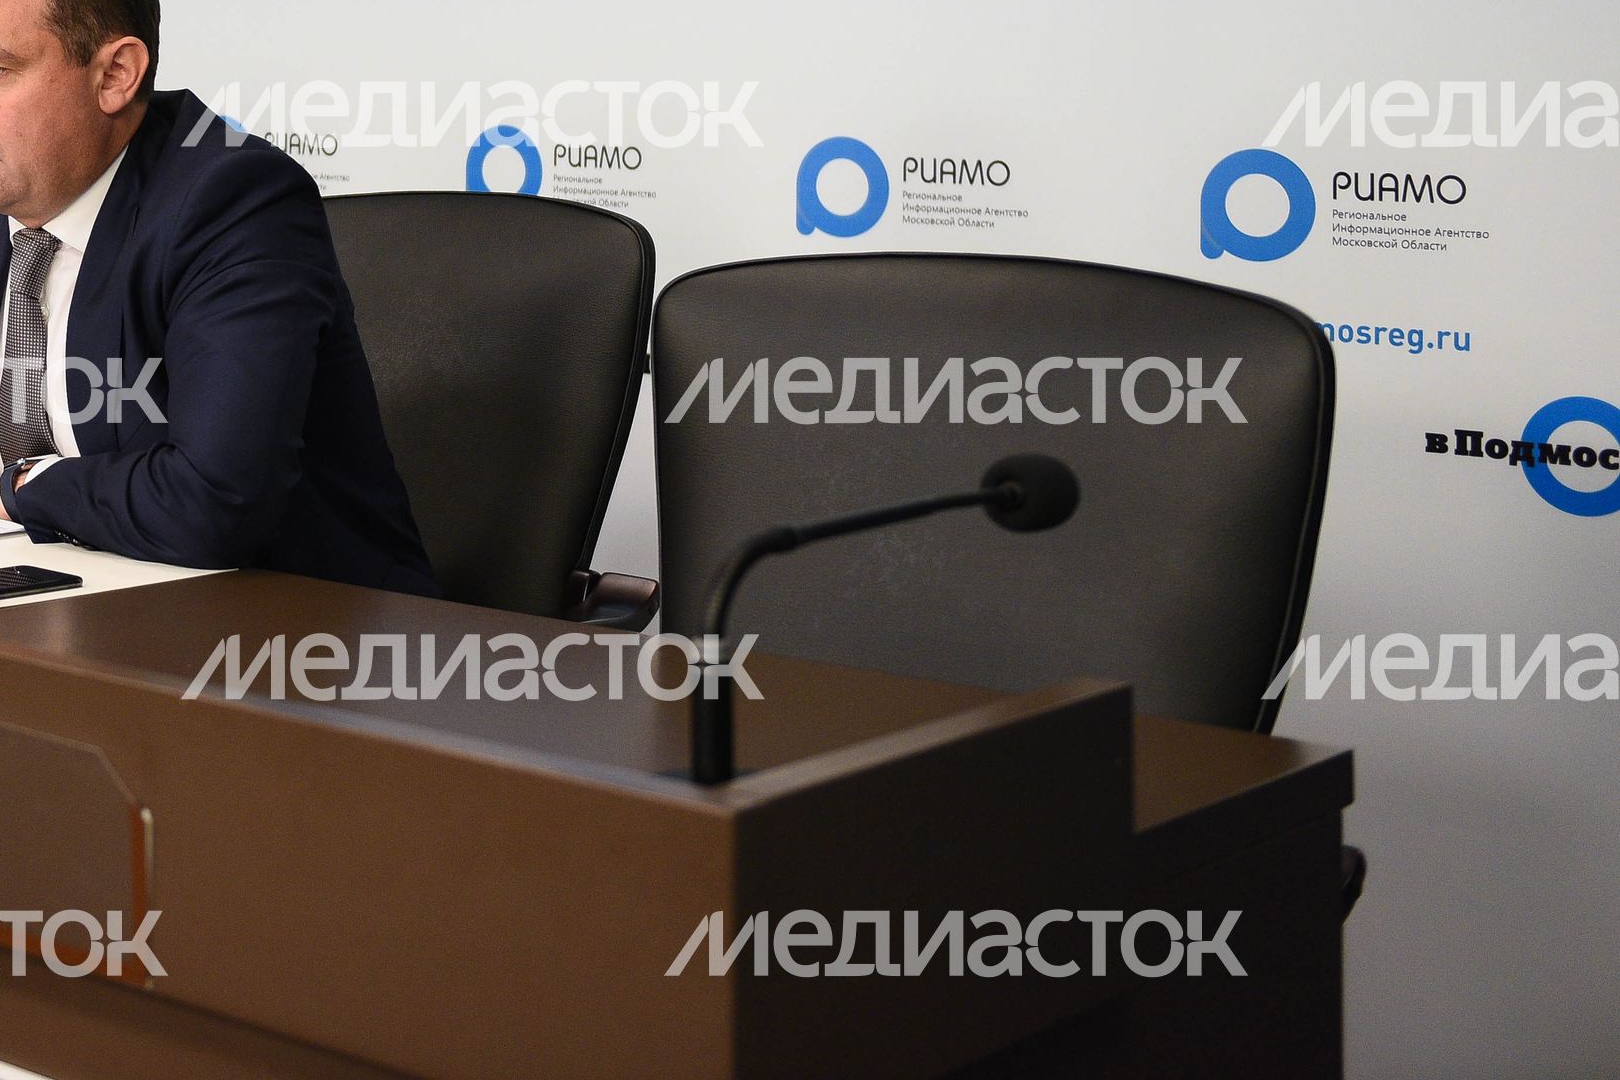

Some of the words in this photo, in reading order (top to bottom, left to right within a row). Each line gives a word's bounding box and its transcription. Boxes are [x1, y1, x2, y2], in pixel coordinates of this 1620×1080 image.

[553, 144, 642, 170] РИАМО
[553, 174, 602, 184] Региональное
[903, 157, 1011, 187] РИАМО
[553, 185, 618, 197] Информационное
[620, 189, 657, 199] Агентство
[1332, 171, 1467, 205] РИАМО
[902, 191, 962, 202] Региональное
[902, 203, 982, 215] Информационное
[984, 207, 1029, 218] Агентство
[1332, 209, 1407, 222] Региональное
[902, 215, 955, 226] Московской
[958, 217, 995, 228] Области
[1332, 223, 1432, 236] Информационное
[1434, 227, 1490, 239] Агентство
[1332, 237, 1398, 249] Московской
[1401, 239, 1447, 251] Области
